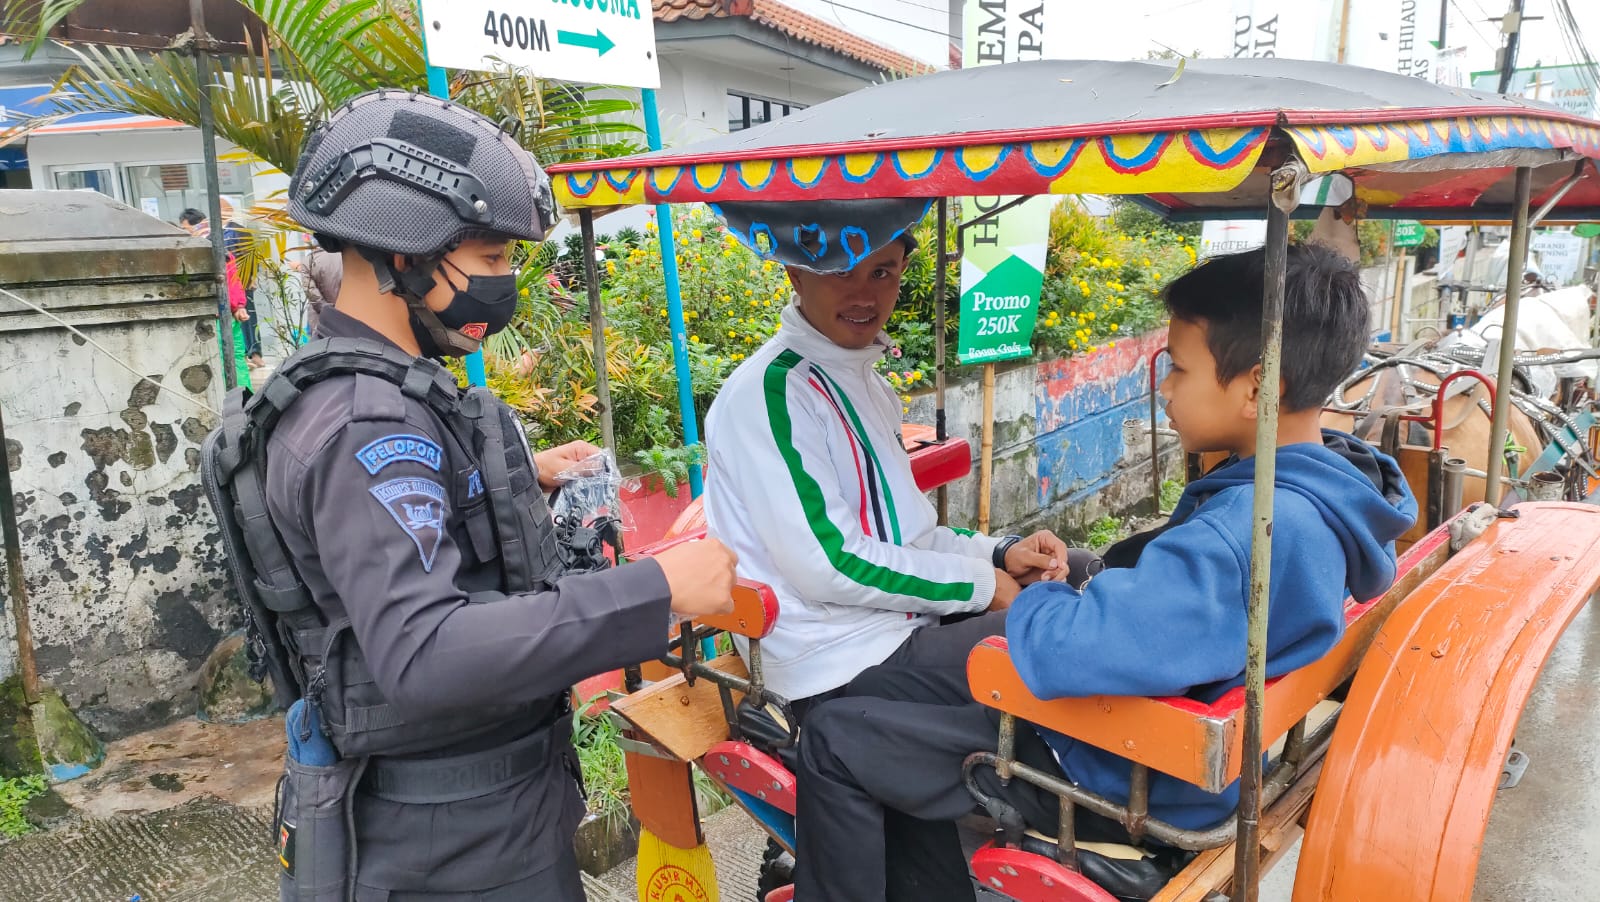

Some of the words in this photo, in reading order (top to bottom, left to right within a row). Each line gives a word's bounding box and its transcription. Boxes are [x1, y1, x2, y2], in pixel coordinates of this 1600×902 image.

[484, 10, 550, 52] 400M
[1212, 240, 1249, 251] HOTEL
[972, 292, 1031, 311] Promo
[976, 315, 1022, 336] 250K
[365, 440, 439, 466] PELOPOR
